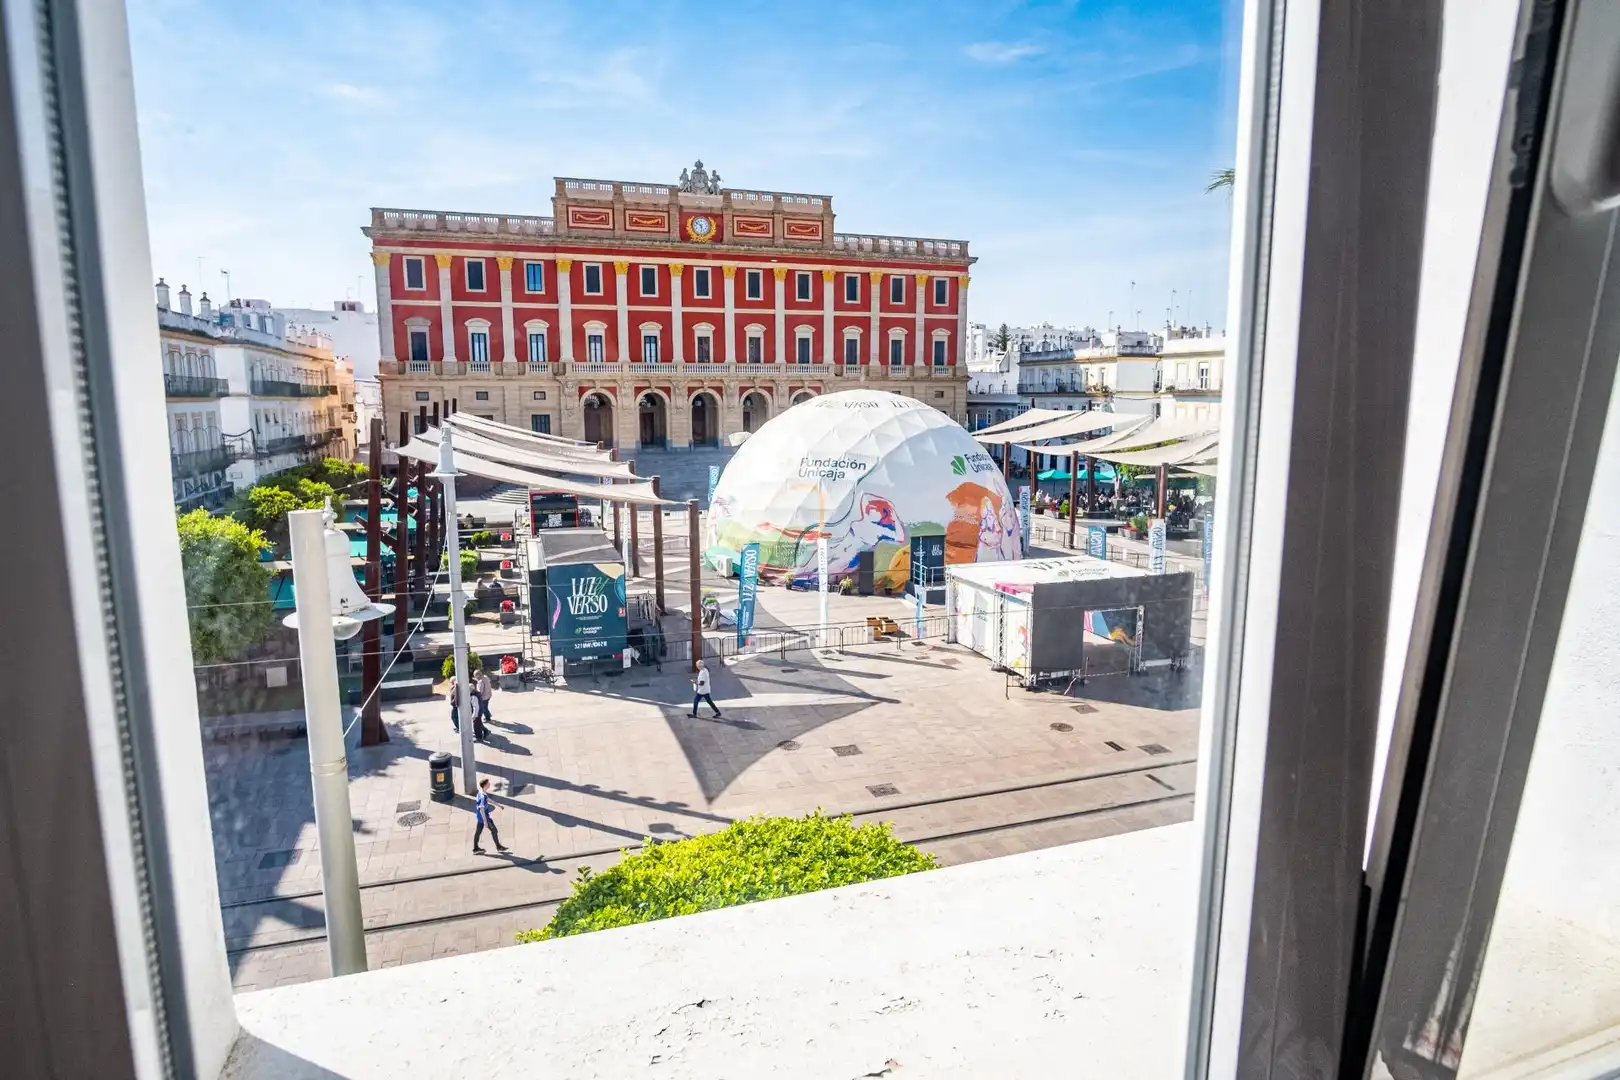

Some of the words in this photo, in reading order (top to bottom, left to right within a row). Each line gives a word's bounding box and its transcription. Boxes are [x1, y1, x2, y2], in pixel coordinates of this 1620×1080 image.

[800, 457, 867, 470] Fundación
[798, 467, 845, 481] Unicaja
[744, 549, 757, 578] VERSO
[571, 577, 596, 597] LUZ
[566, 594, 608, 615] VERSO
